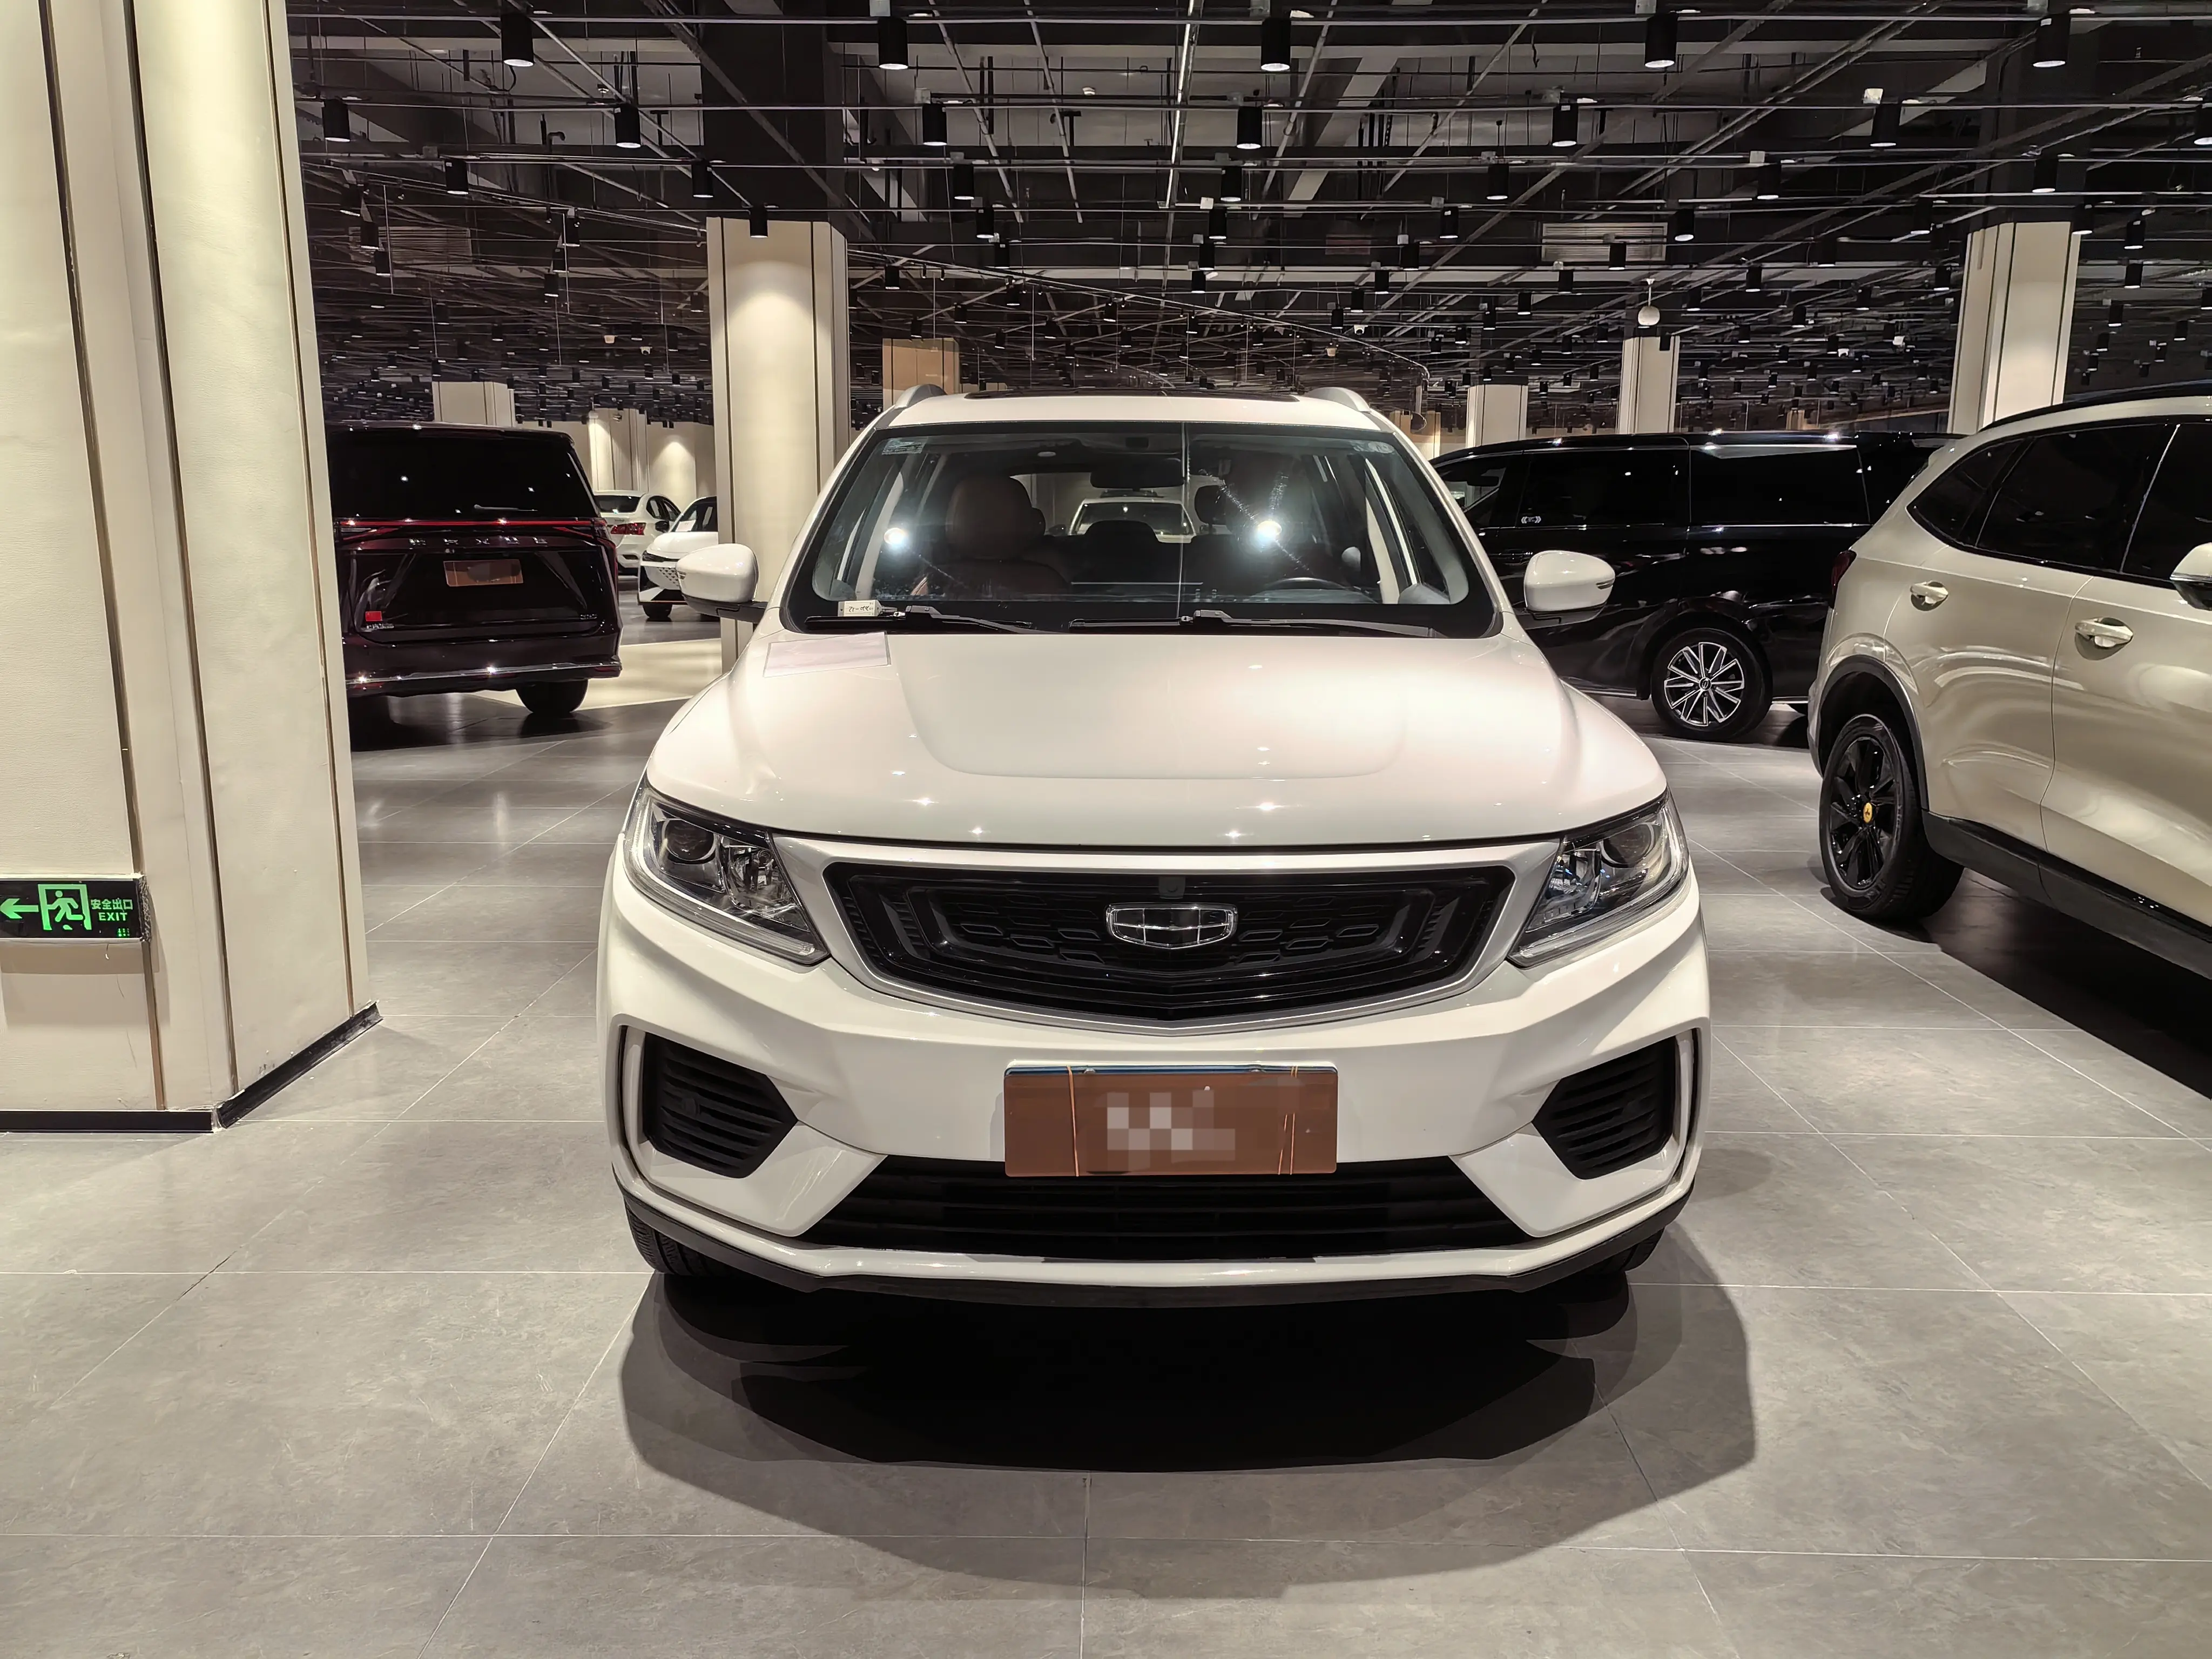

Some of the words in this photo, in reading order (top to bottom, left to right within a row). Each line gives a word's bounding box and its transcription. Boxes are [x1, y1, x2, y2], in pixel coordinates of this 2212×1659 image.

[91, 899, 133, 910] 安全出口
[98, 912, 127, 921] EXIT
